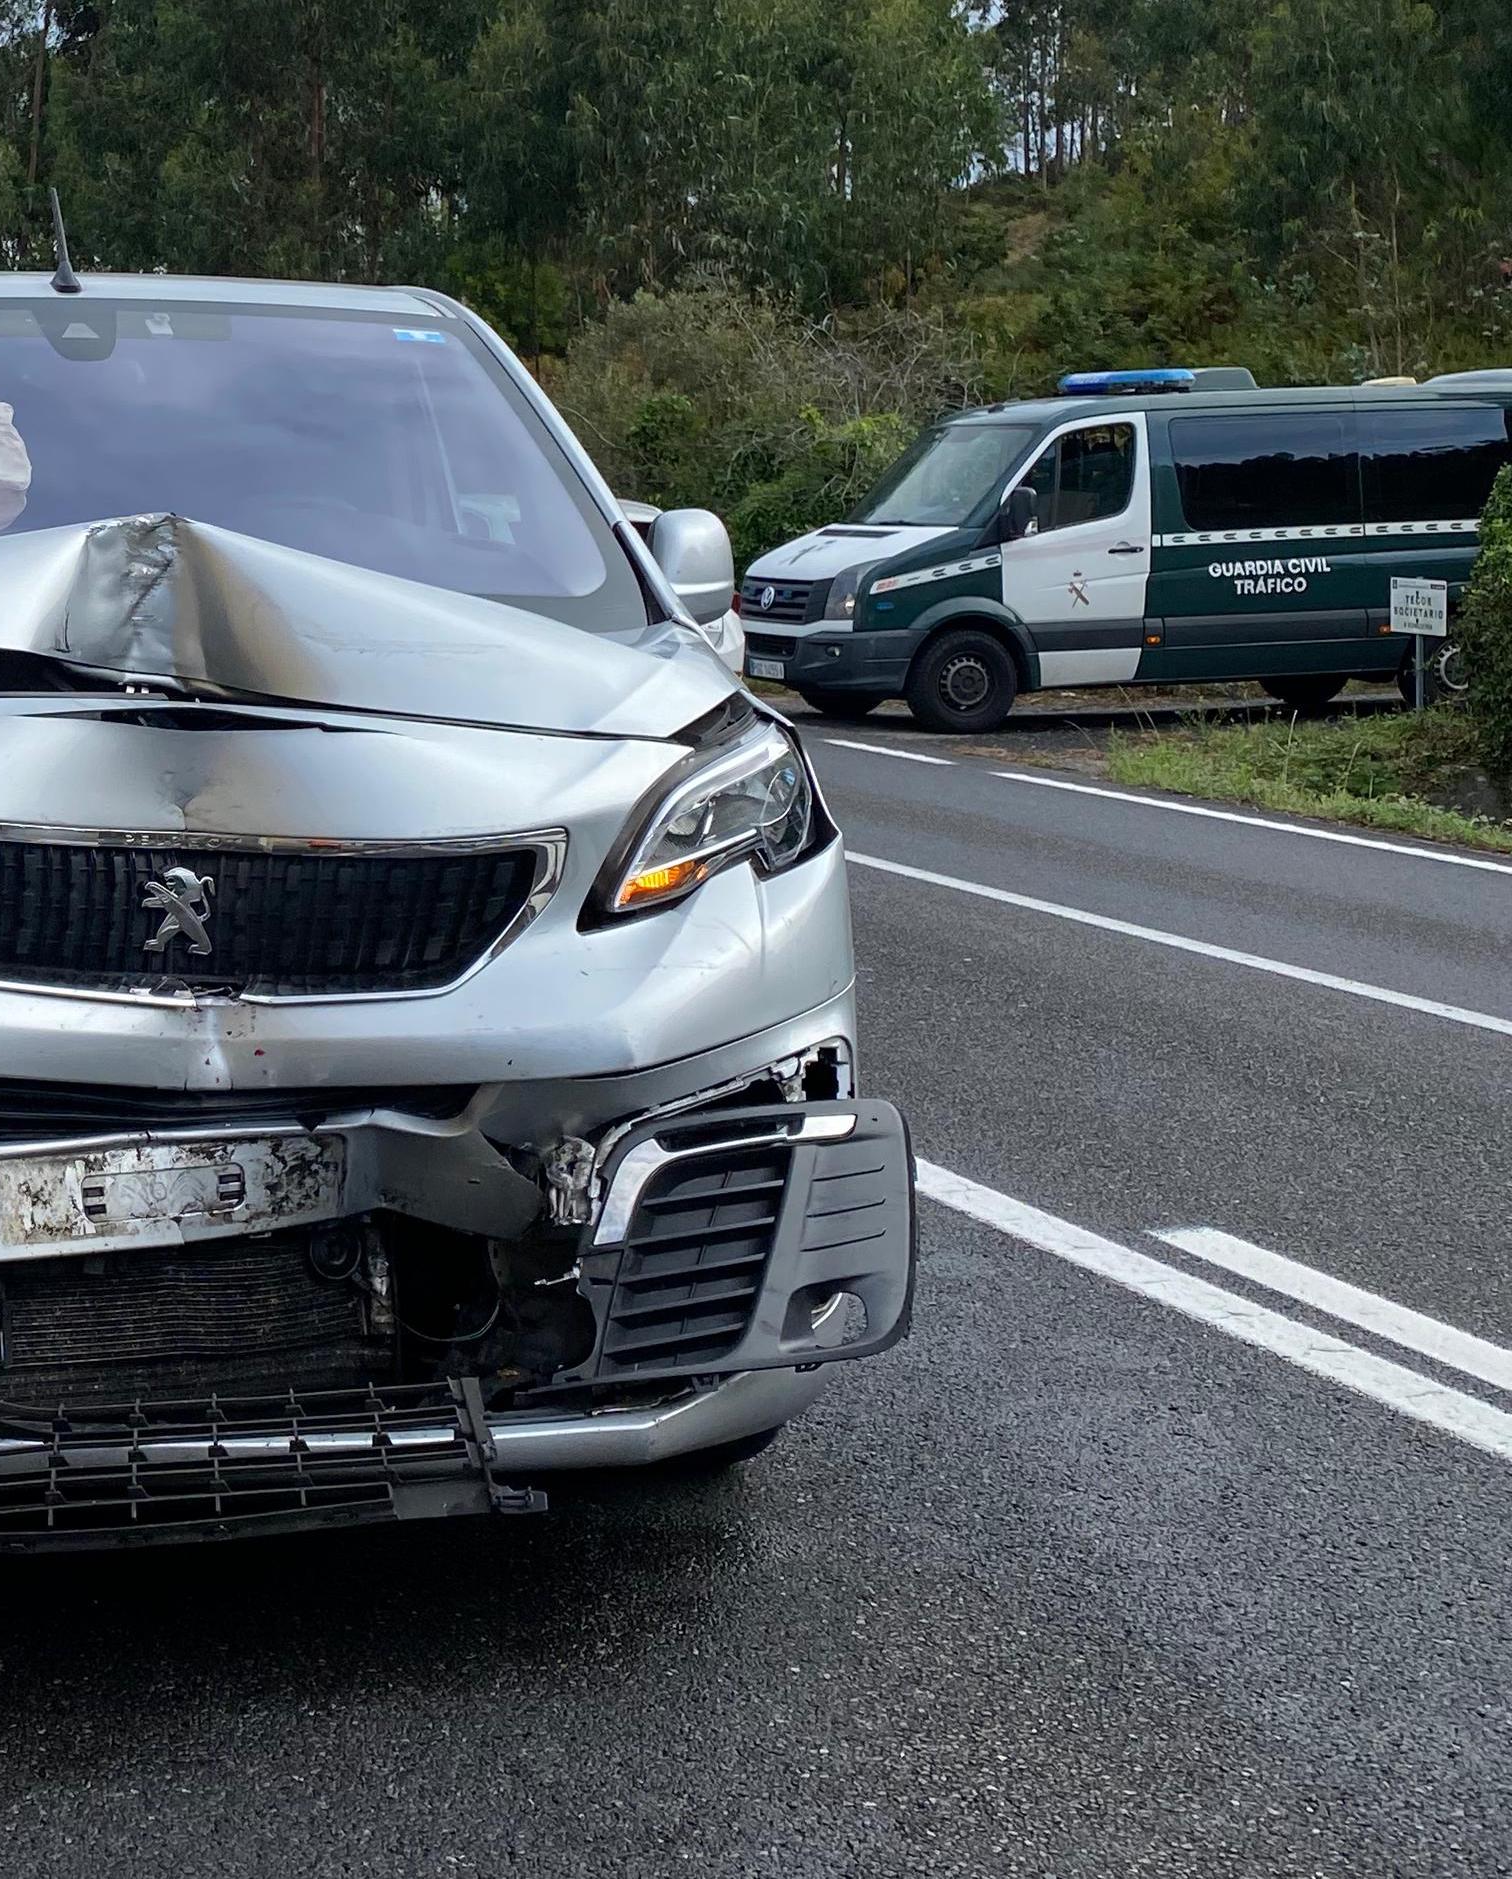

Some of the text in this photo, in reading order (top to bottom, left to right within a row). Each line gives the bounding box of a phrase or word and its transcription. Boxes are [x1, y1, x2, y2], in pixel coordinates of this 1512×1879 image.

[1208, 557, 1331, 578] GUARDIA CIVIL
[1234, 576, 1307, 595] TRÁFICO
